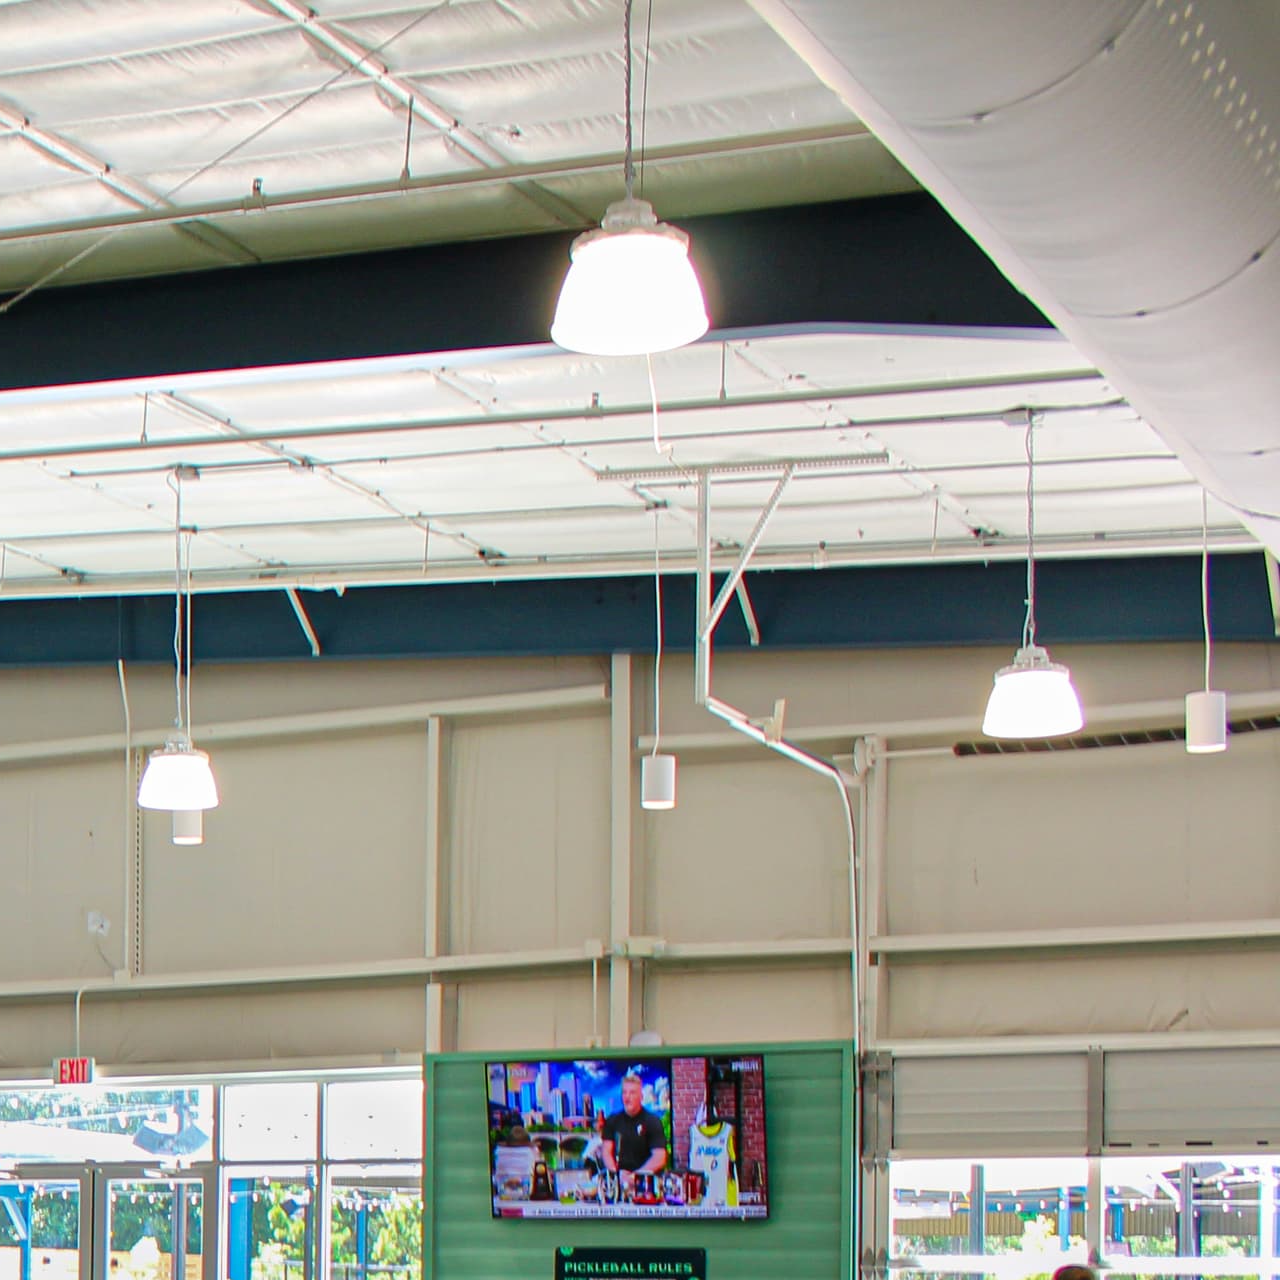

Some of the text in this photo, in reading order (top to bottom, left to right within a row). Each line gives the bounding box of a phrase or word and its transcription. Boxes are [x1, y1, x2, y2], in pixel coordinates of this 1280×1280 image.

[59, 1058, 89, 1085] EXIT
[564, 1261, 693, 1274] PICKLEBALL RULES
